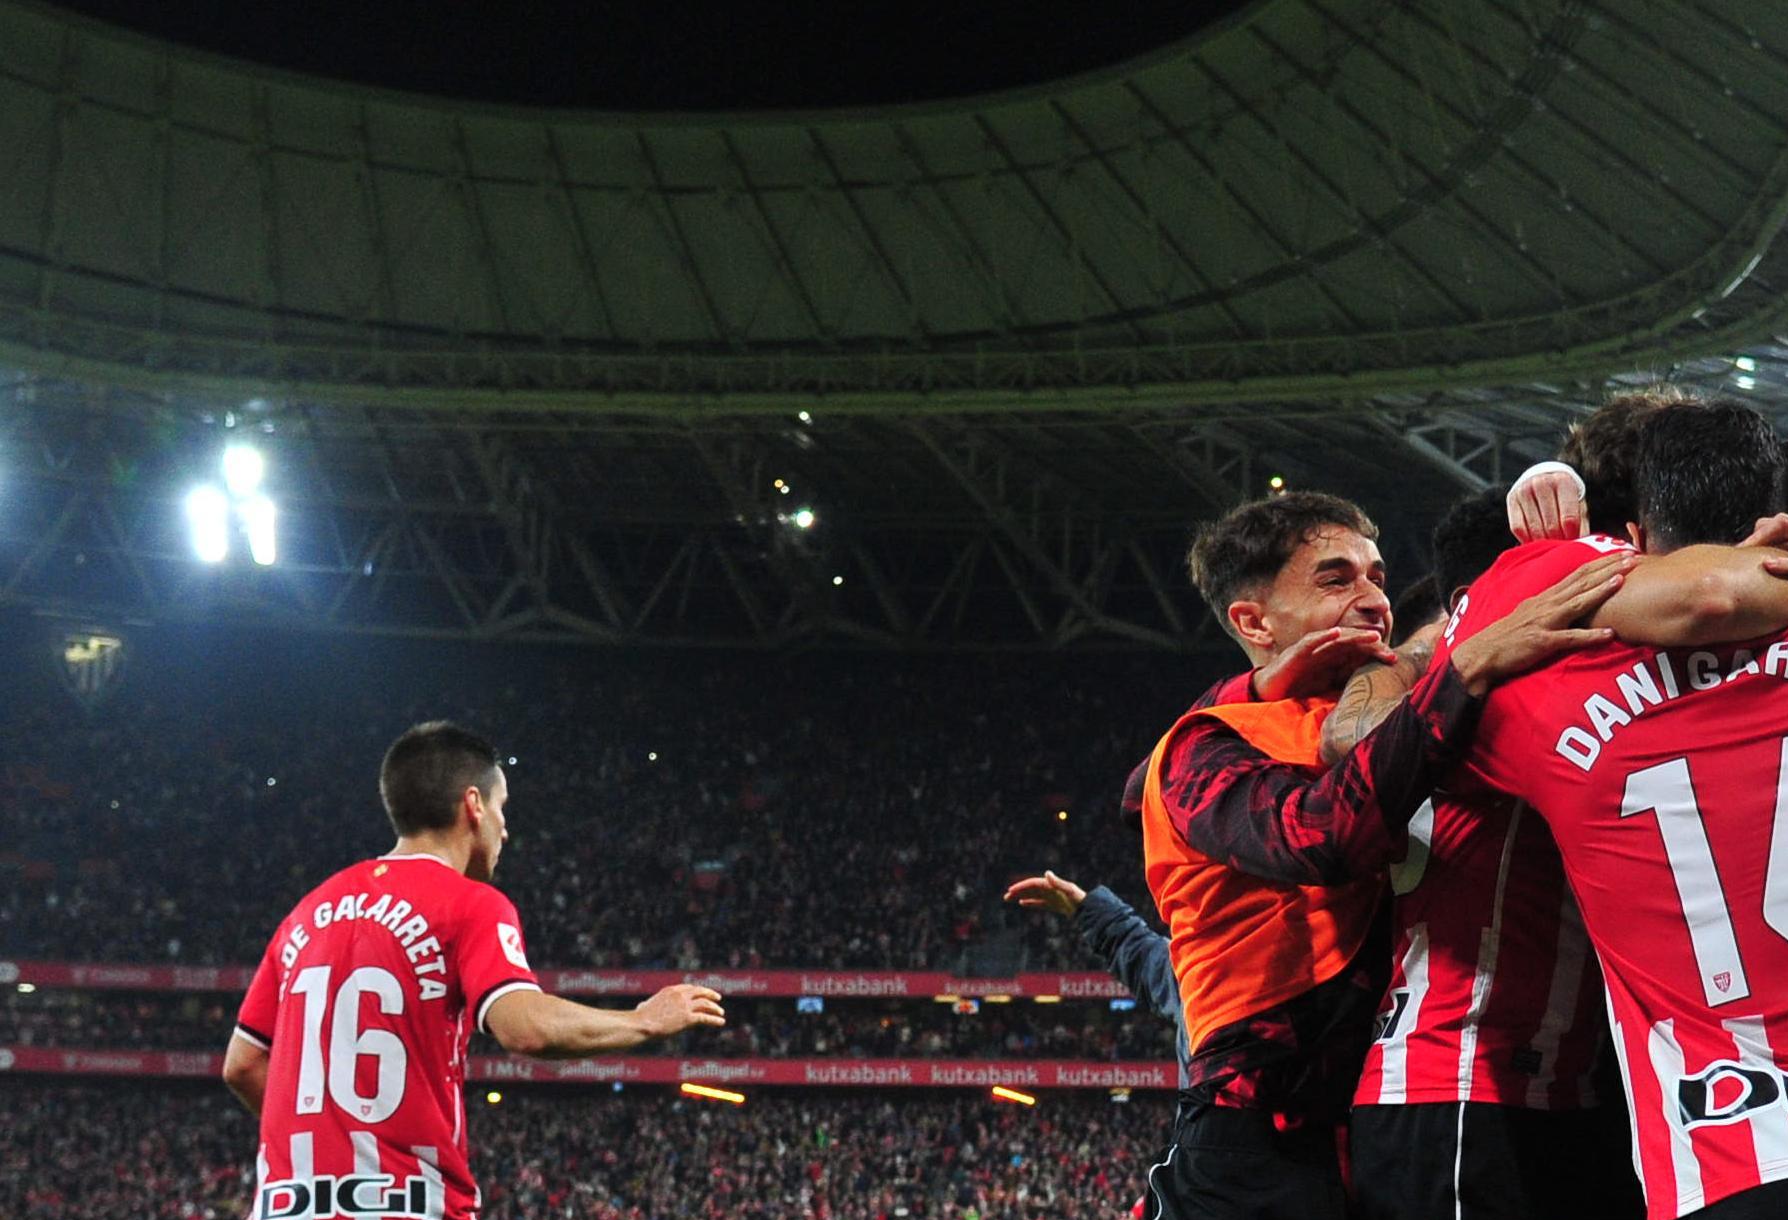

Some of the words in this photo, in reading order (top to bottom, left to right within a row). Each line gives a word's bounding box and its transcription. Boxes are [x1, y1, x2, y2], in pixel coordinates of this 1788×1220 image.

[1555, 650, 1680, 772] DANI
[279, 922, 311, 970] DE
[313, 892, 447, 1001] GALARRETA
[800, 974, 908, 996] kutxabank
[290, 964, 408, 1124] 16
[804, 1064, 913, 1085] kutxabank
[930, 1065, 1039, 1086] kutxabank
[1055, 1066, 1165, 1087] kutxabank
